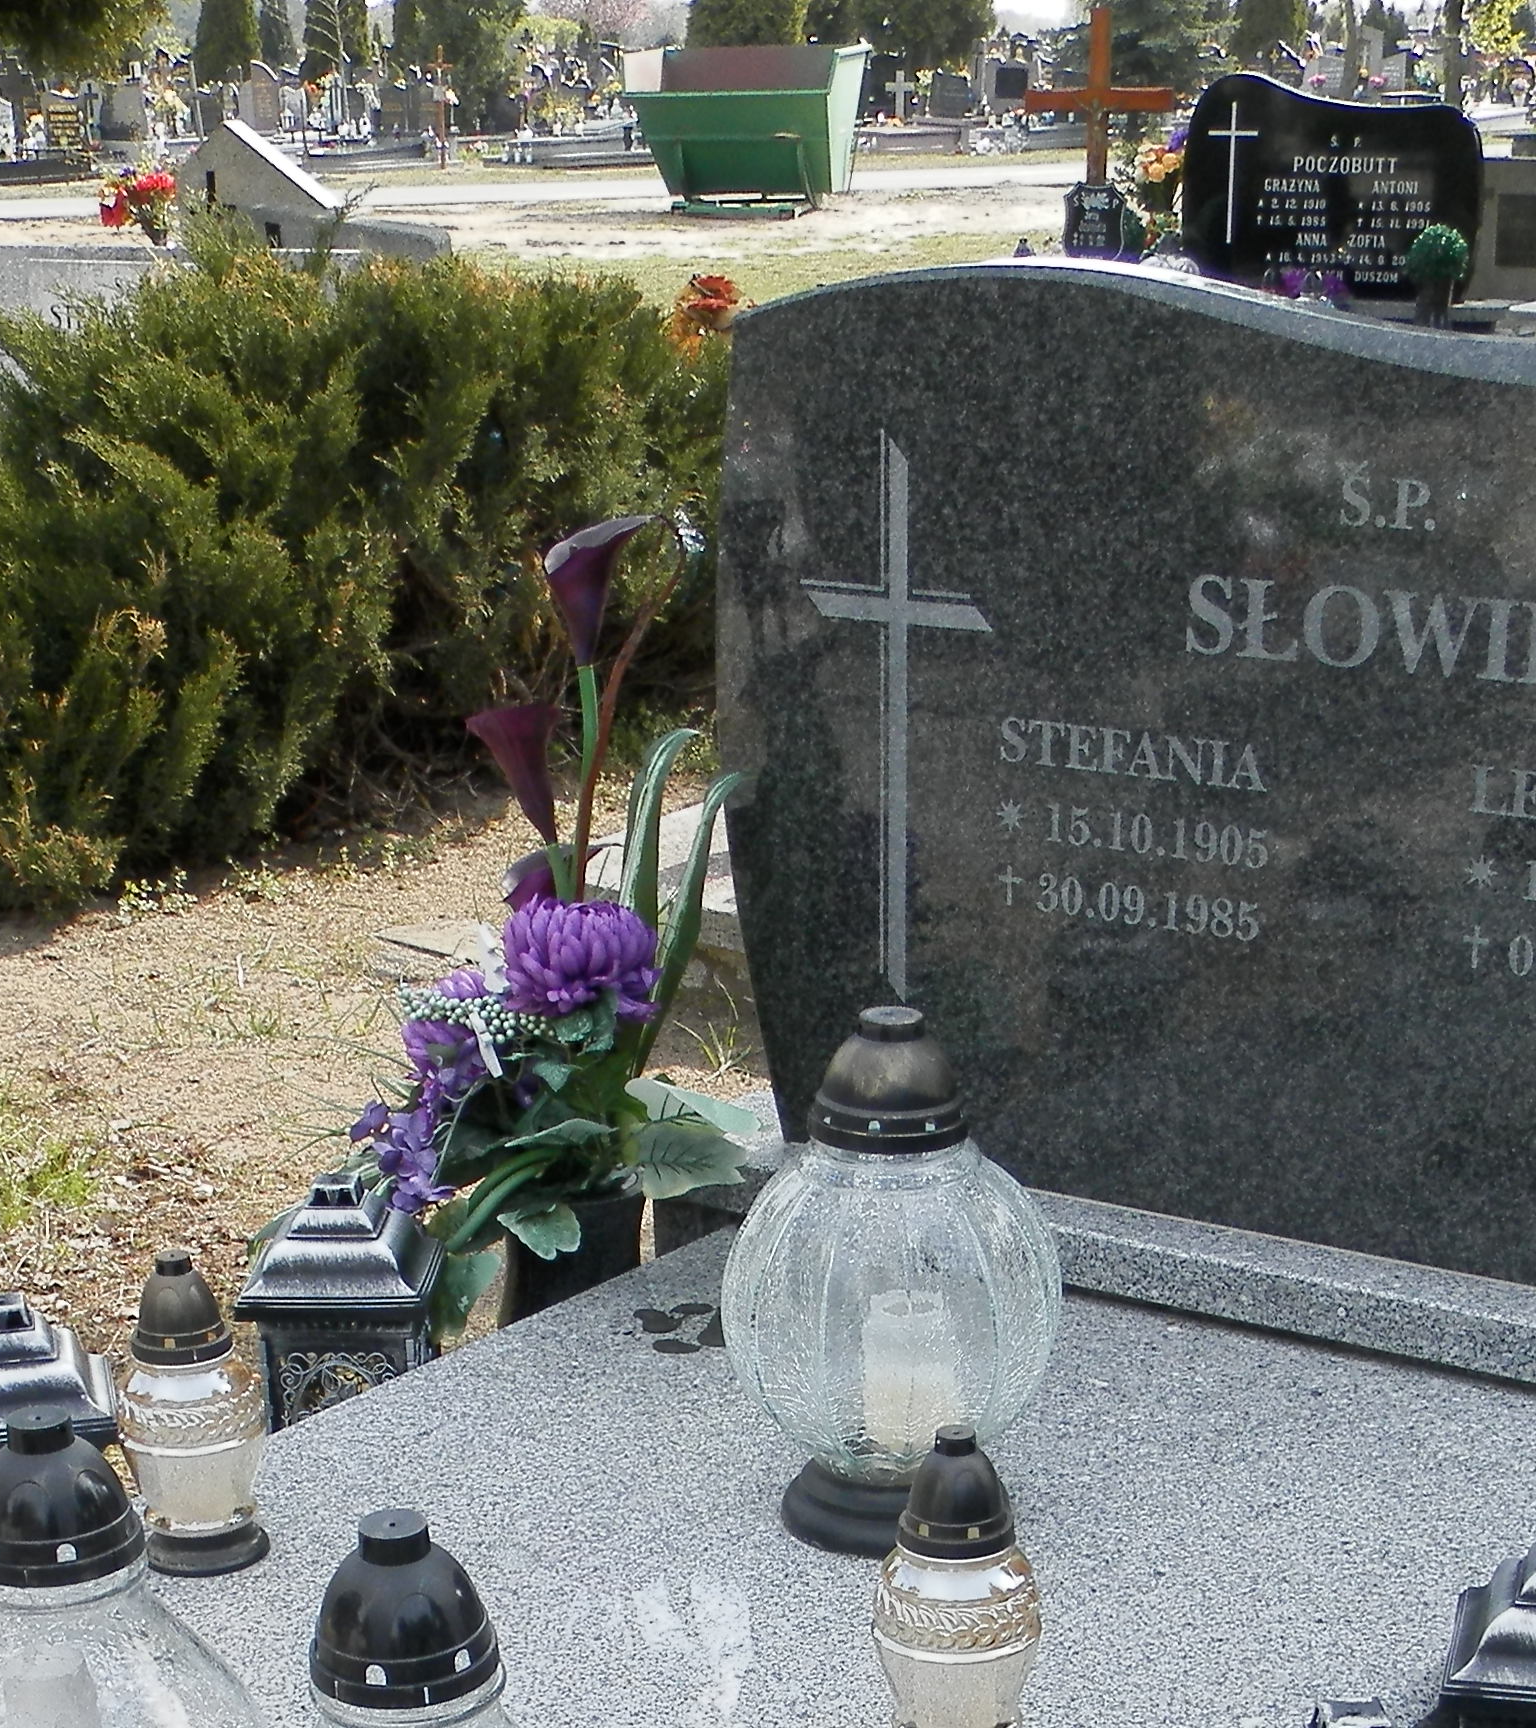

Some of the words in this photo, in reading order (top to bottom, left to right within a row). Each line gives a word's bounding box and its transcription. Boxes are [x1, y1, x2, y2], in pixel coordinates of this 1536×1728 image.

[1293, 156, 1399, 174] POCZOBUTT
[1372, 180, 1419, 195] ANTONI
[1295, 233, 1327, 247] ANNA
[1349, 234, 1386, 249] ZOFIA
[1355, 270, 1399, 284] DUSZOM
[999, 716, 1268, 793] STEFANIA
[1046, 801, 1269, 870] 15.10.1905
[1035, 871, 1261, 942] 30.09.1985
